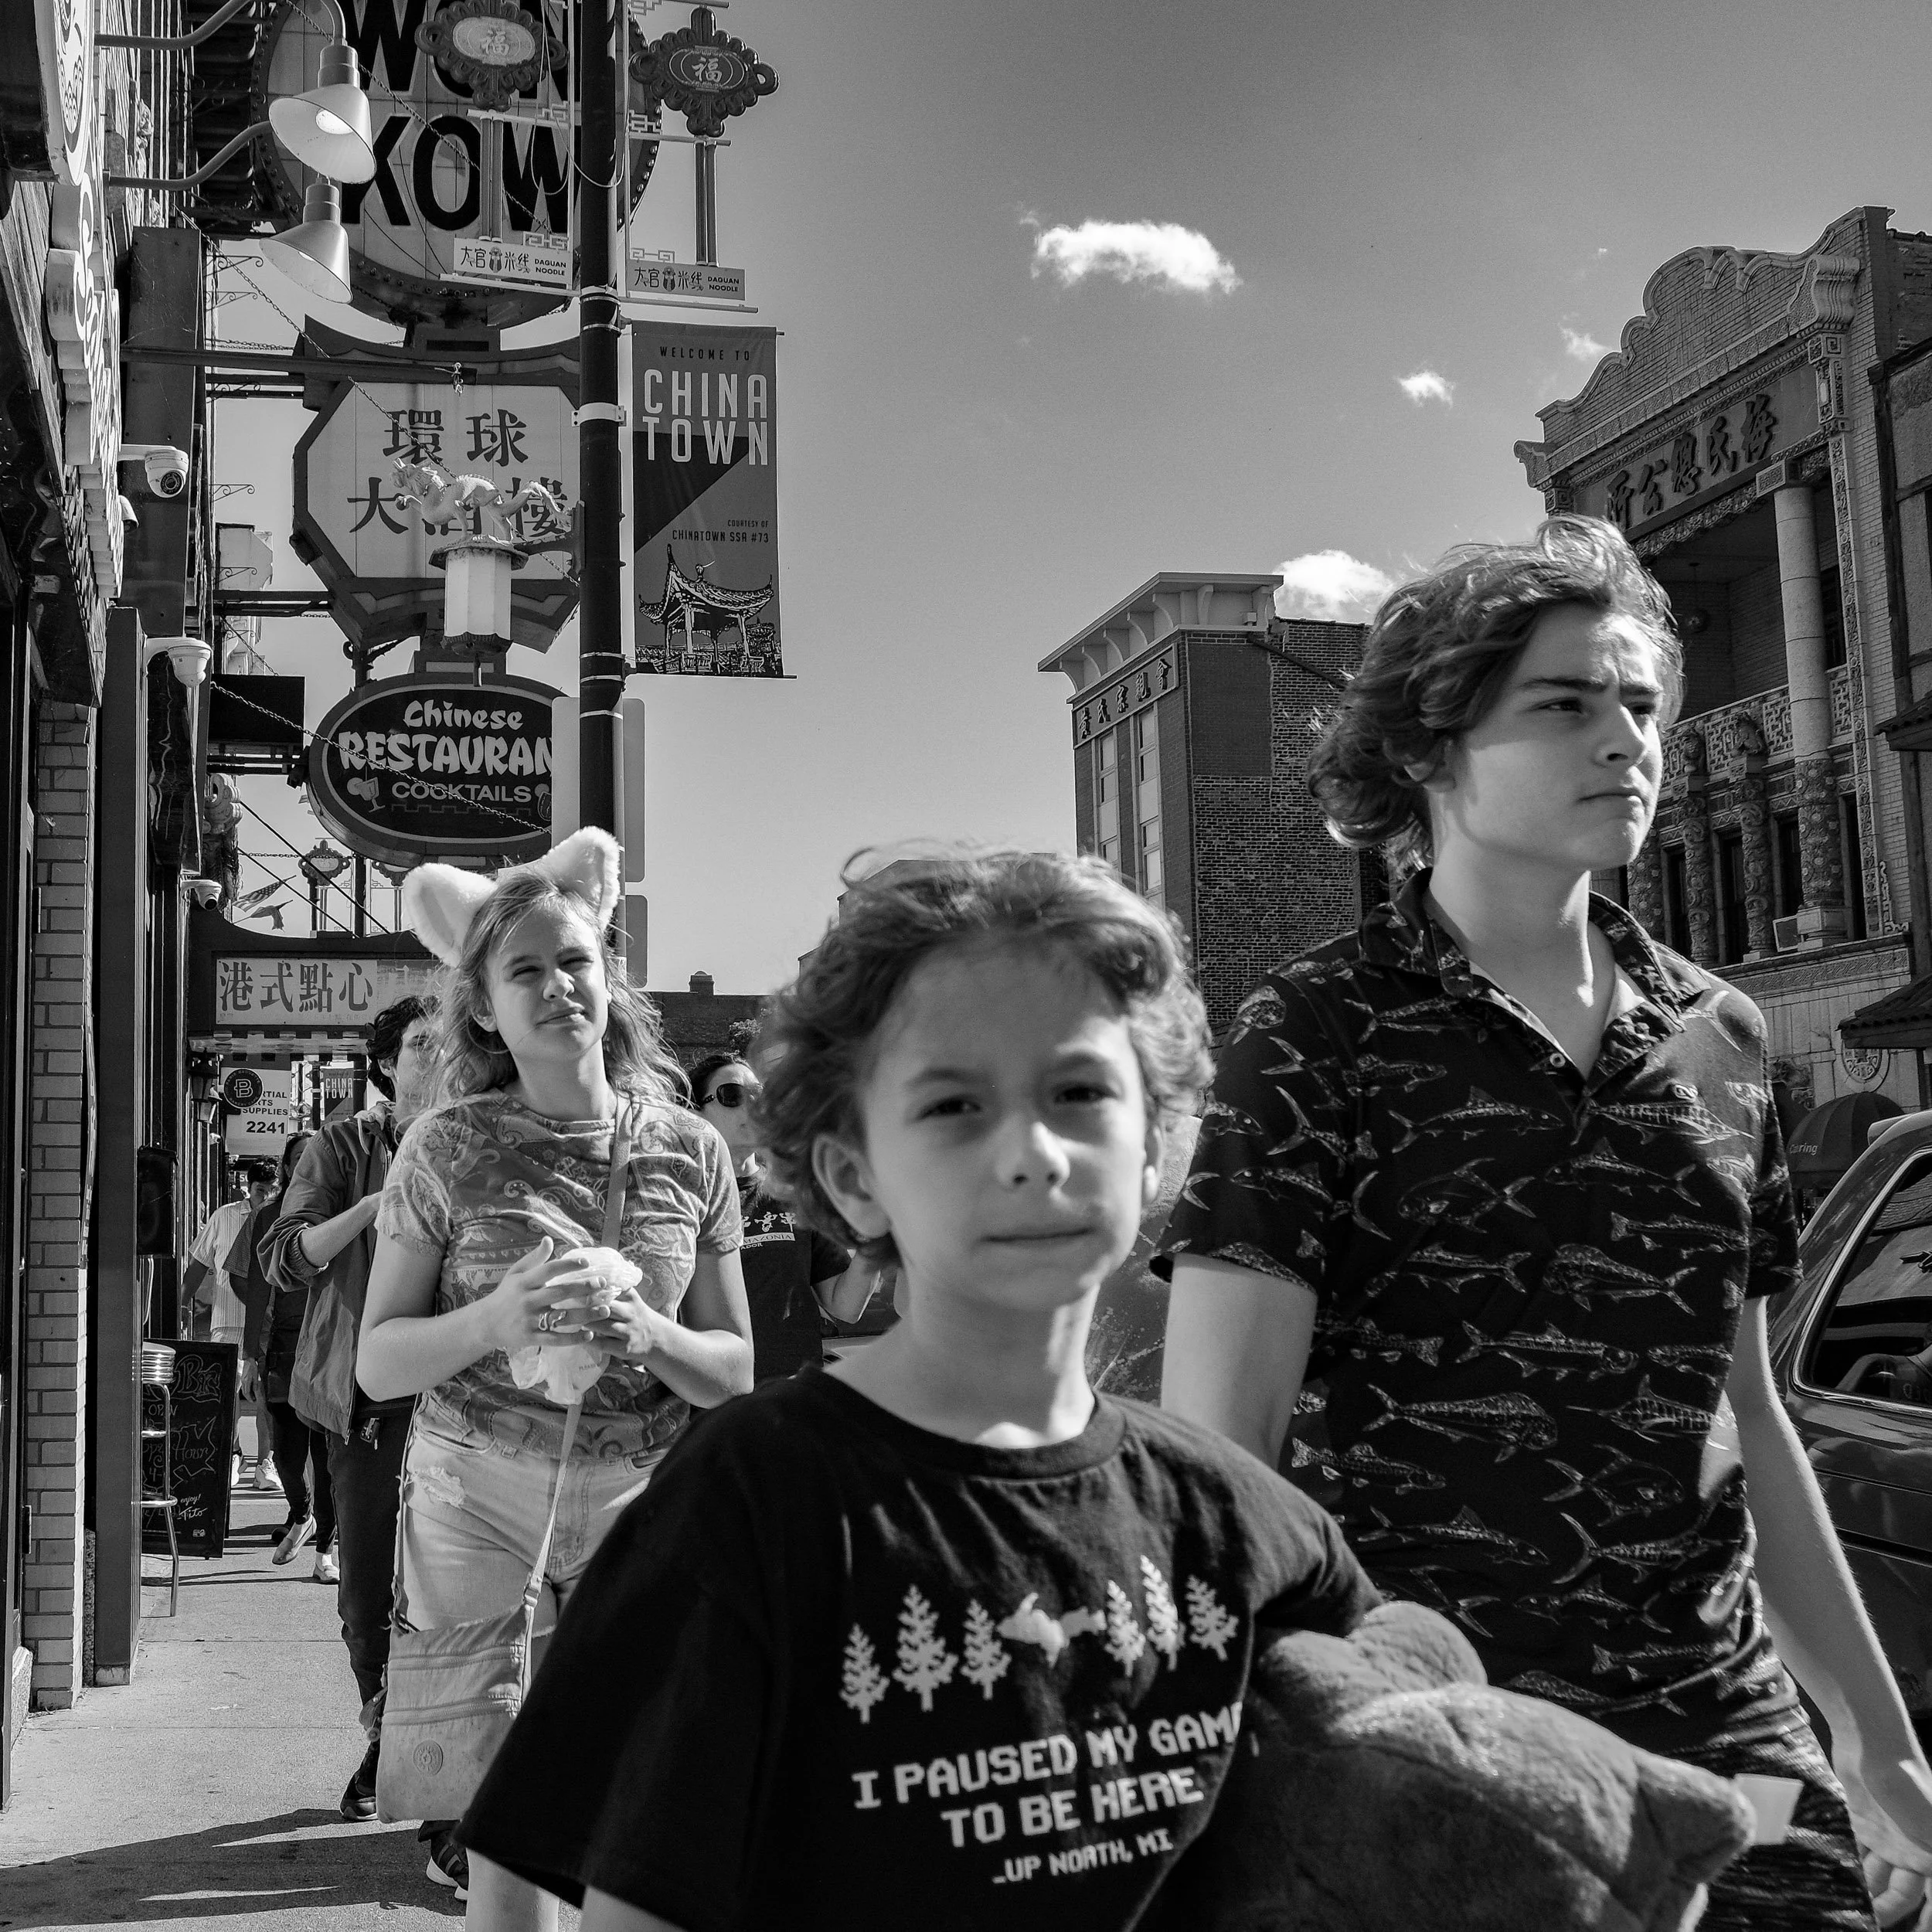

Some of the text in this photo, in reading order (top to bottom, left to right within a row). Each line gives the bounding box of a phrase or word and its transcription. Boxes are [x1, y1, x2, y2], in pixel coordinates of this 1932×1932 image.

[691, 56, 723, 83] 福
[340, 115, 581, 231] KOW
[534, 258, 566, 268] DAGUAN
[536, 267, 565, 276] NOODLE
[707, 276, 740, 284] DAGUAN
[660, 346, 750, 361] WELCOME TO
[644, 369, 767, 419] CHINA
[383, 409, 529, 467] 環球
[642, 416, 768, 465] TOWN
[727, 519, 759, 528] COURTESY
[672, 529, 769, 543] CHINATOWN SSA #73
[403, 699, 524, 730] Chinese
[338, 731, 552, 777] RESTAURAN
[391, 781, 532, 803] COCKTAILS
[219, 961, 373, 1013] 港式點心
[325, 1077, 353, 1089] CHINA
[325, 1088, 353, 1099] TOWN
[242, 1107, 288, 1116] SUPPLIES
[246, 1121, 284, 1134] 2241
[148, 1403, 179, 1417] OPN
[180, 1493, 201, 1506] enjoy!
[851, 1770, 882, 1809] I
[893, 1733, 1078, 1804] PAUSED
[1086, 1723, 1138, 1768] MY
[940, 1766, 1205, 1849] TO BE HERE
[1135, 1828, 1175, 1856] MI
